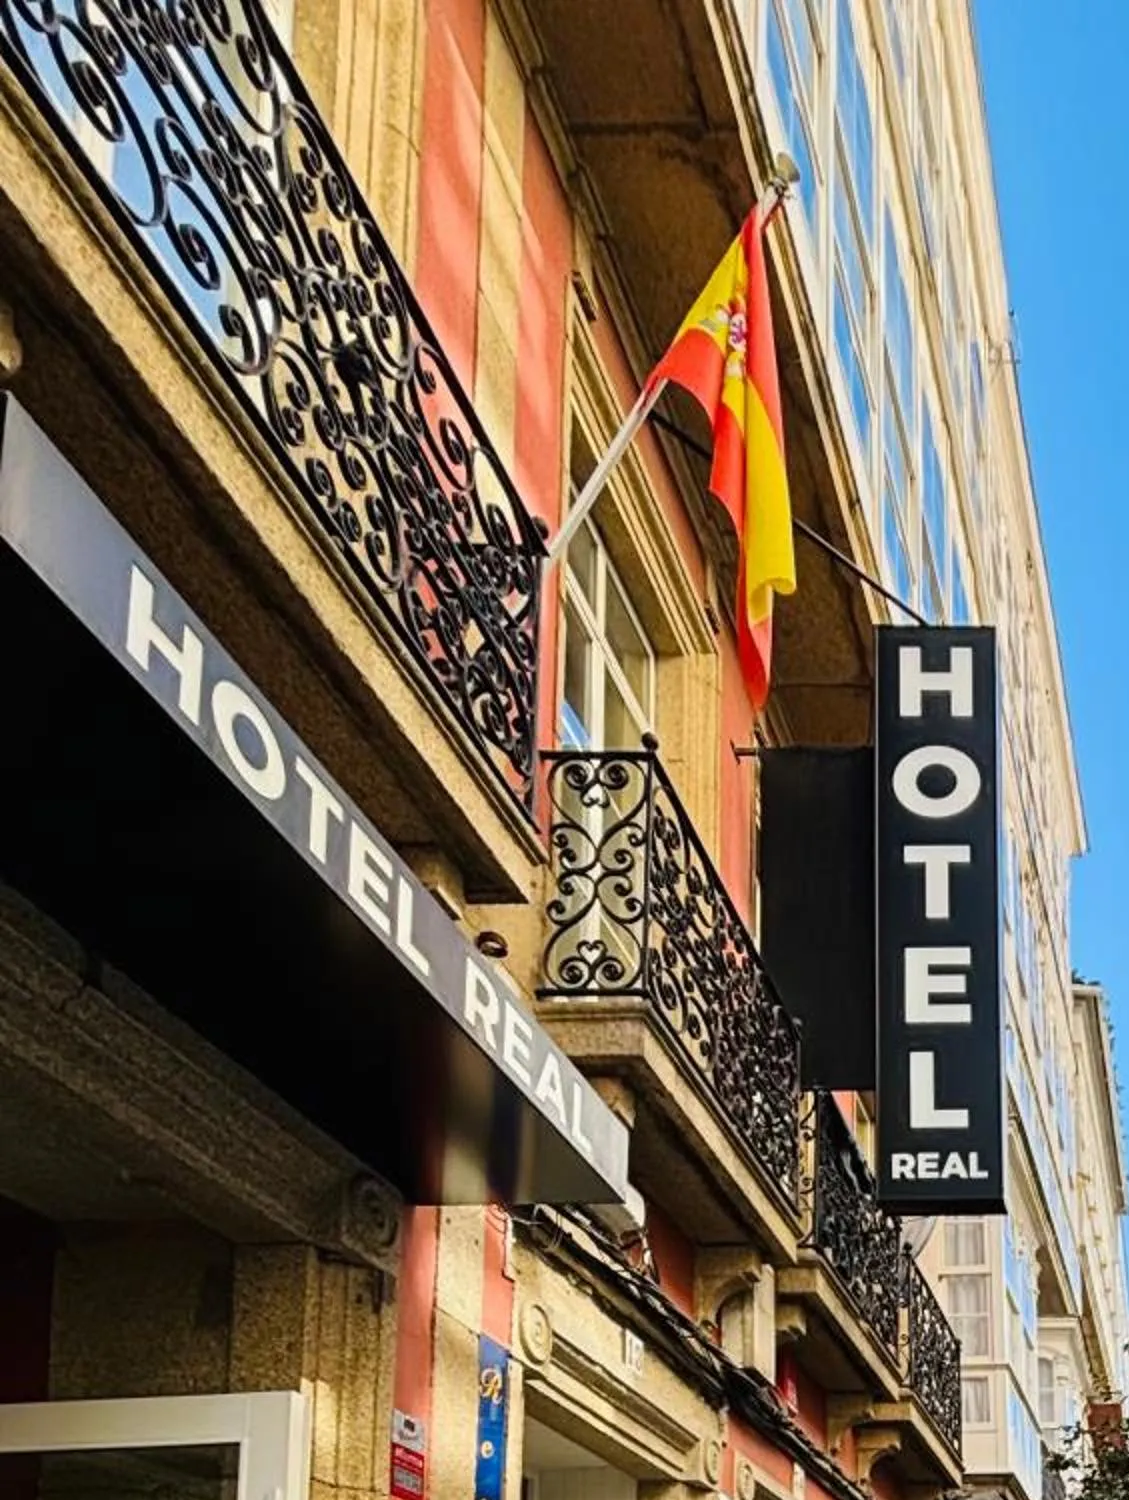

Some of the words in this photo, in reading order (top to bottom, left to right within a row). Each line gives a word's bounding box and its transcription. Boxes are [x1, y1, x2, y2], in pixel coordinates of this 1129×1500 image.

[126, 563, 430, 977] HOTEL
[463, 956, 592, 1154] REAL
[892, 646, 982, 1129] HOTEL
[890, 1152, 989, 1180] REAL
